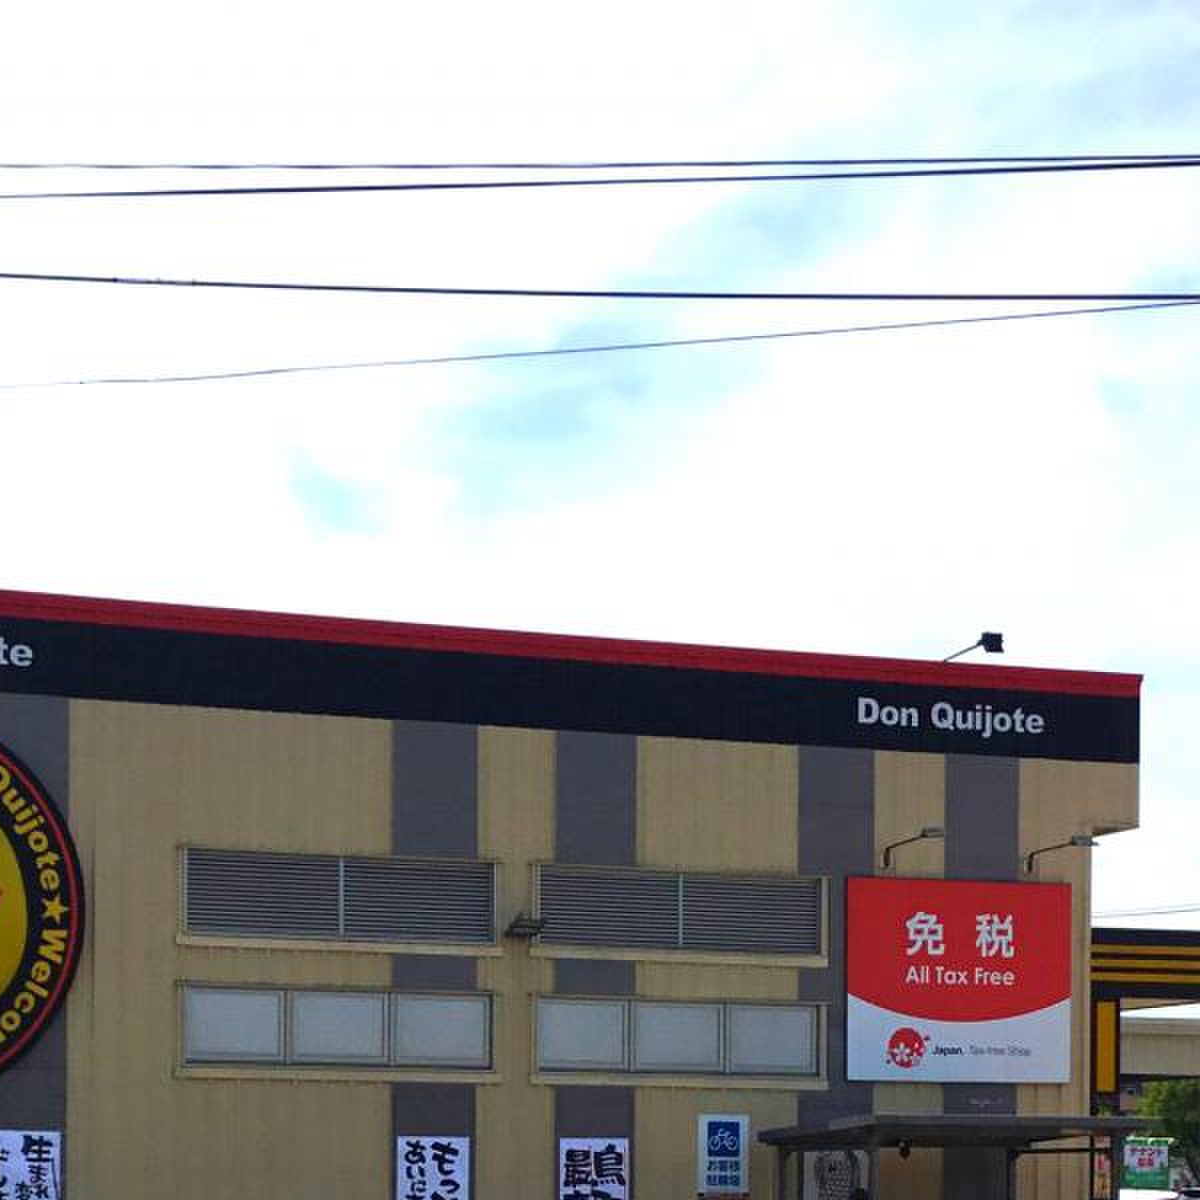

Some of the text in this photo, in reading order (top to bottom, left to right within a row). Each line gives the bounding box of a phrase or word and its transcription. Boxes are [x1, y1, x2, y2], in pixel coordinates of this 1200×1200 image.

[857, 696, 1046, 738] Don Quijote
[905, 965, 1015, 986] All Tax Free
